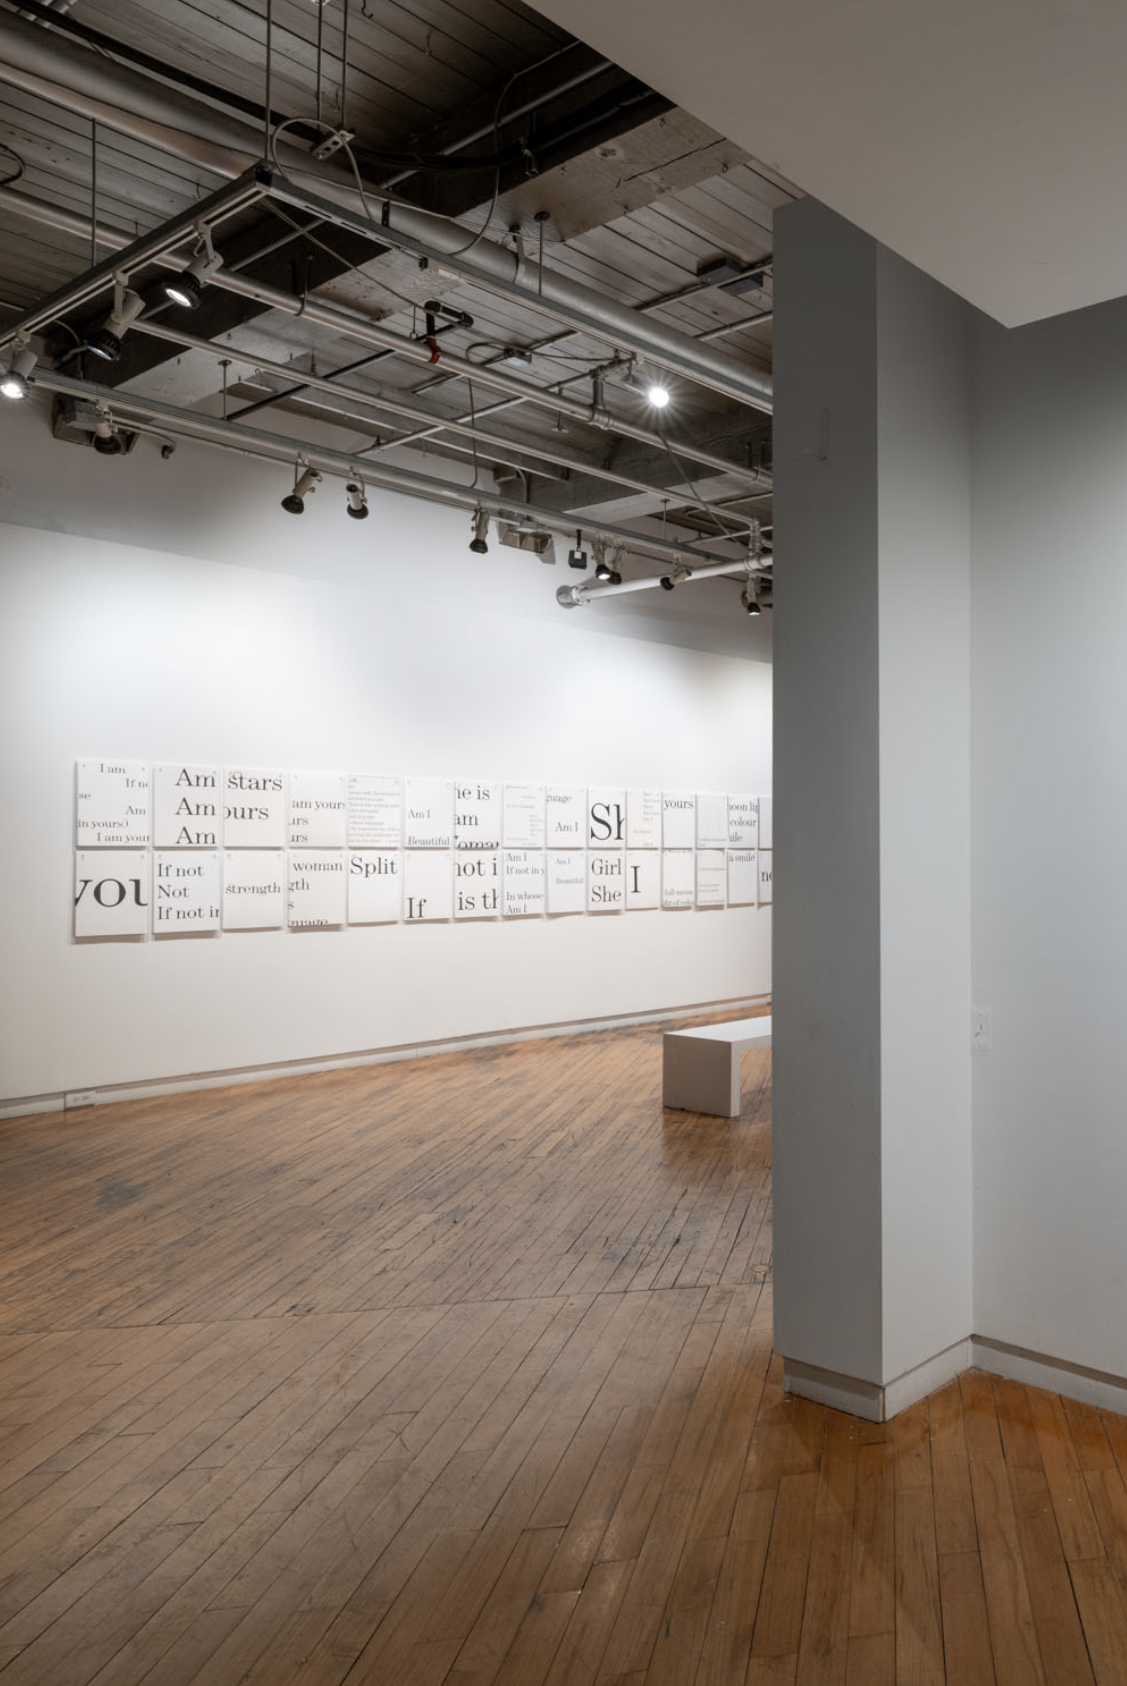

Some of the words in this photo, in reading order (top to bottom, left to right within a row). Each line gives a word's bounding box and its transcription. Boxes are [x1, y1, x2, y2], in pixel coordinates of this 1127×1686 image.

[99, 764, 104, 773] I
[126, 778, 136, 788] If
[174, 768, 216, 787] Am
[227, 771, 283, 791] stars
[476, 785, 490, 800] is
[125, 805, 146, 815] Am
[174, 797, 216, 816] Am
[291, 800, 312, 809] am
[664, 800, 693, 811] yours
[408, 809, 424, 819] Am
[92, 819, 129, 830] yours)
[555, 822, 572, 832] Am
[730, 816, 757, 827] colour
[97, 832, 102, 841] I
[105, 834, 122, 842] am
[174, 826, 216, 844] Am
[408, 836, 450, 845] Beautiful
[506, 853, 521, 862] Am
[735, 853, 755, 862] smile
[157, 863, 174, 877] If
[176, 864, 204, 877] not
[293, 862, 342, 871] woman
[350, 857, 398, 878] Split
[506, 866, 514, 875] If
[515, 867, 529, 875] not
[531, 865, 540, 875] in
[591, 858, 621, 876] Girl
[631, 866, 641, 893] I
[157, 885, 190, 898] Not
[225, 882, 281, 896] strength
[591, 885, 622, 902] She
[457, 892, 475, 911] is
[506, 892, 516, 901] In
[517, 891, 544, 900] whose
[157, 906, 174, 920] If
[176, 907, 205, 920] not
[407, 897, 427, 919] If
[506, 905, 521, 914] Am
